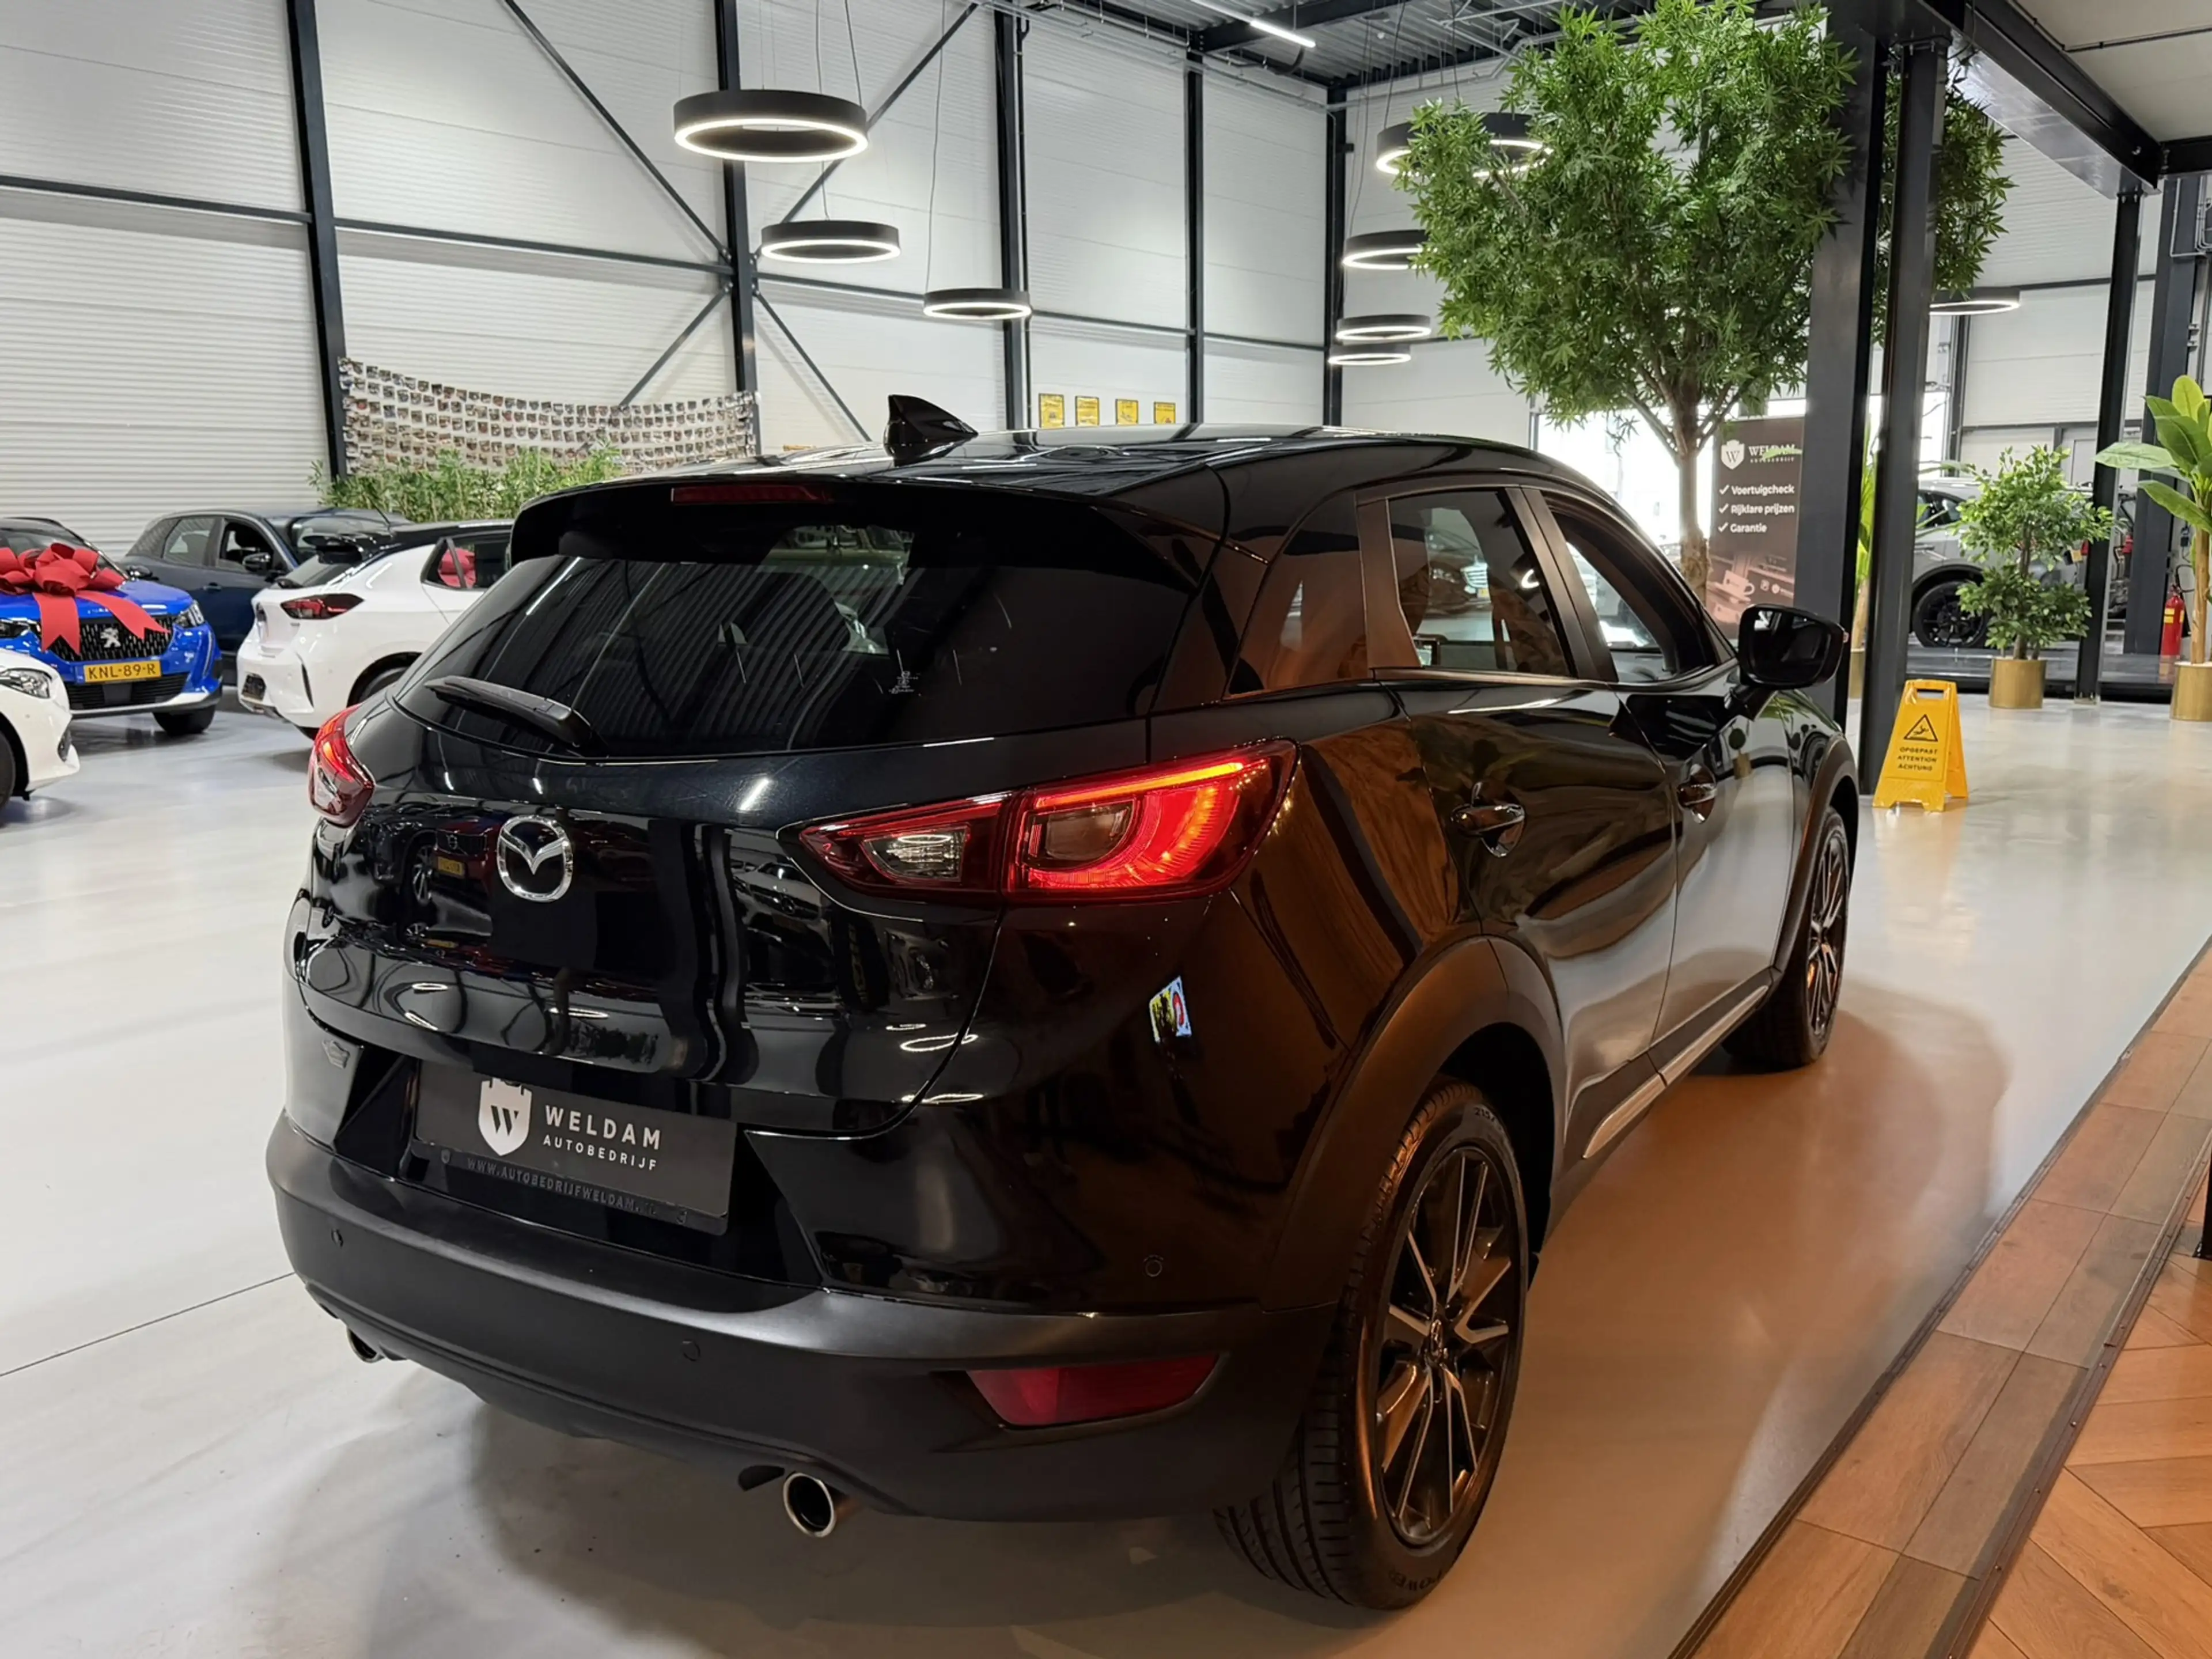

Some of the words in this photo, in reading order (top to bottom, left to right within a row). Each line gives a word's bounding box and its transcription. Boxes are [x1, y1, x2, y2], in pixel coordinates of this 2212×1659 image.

[1726, 451, 1739, 463] W
[1731, 484, 1795, 496] Voertuigcheck
[1730, 504, 1763, 516] Rijklare
[1764, 504, 1795, 515] prijzen
[1730, 524, 1767, 533] Garantie
[1899, 746, 1938, 755] OPGEPAST
[1897, 763, 1933, 771] ACHTUNG
[491, 1105, 520, 1137] W
[545, 1104, 662, 1150] WELDAM
[543, 1135, 657, 1171] AUTOBEDRIJF
[467, 1157, 657, 1215] WWW.AUTOBEDRIJFWELDAM.L
